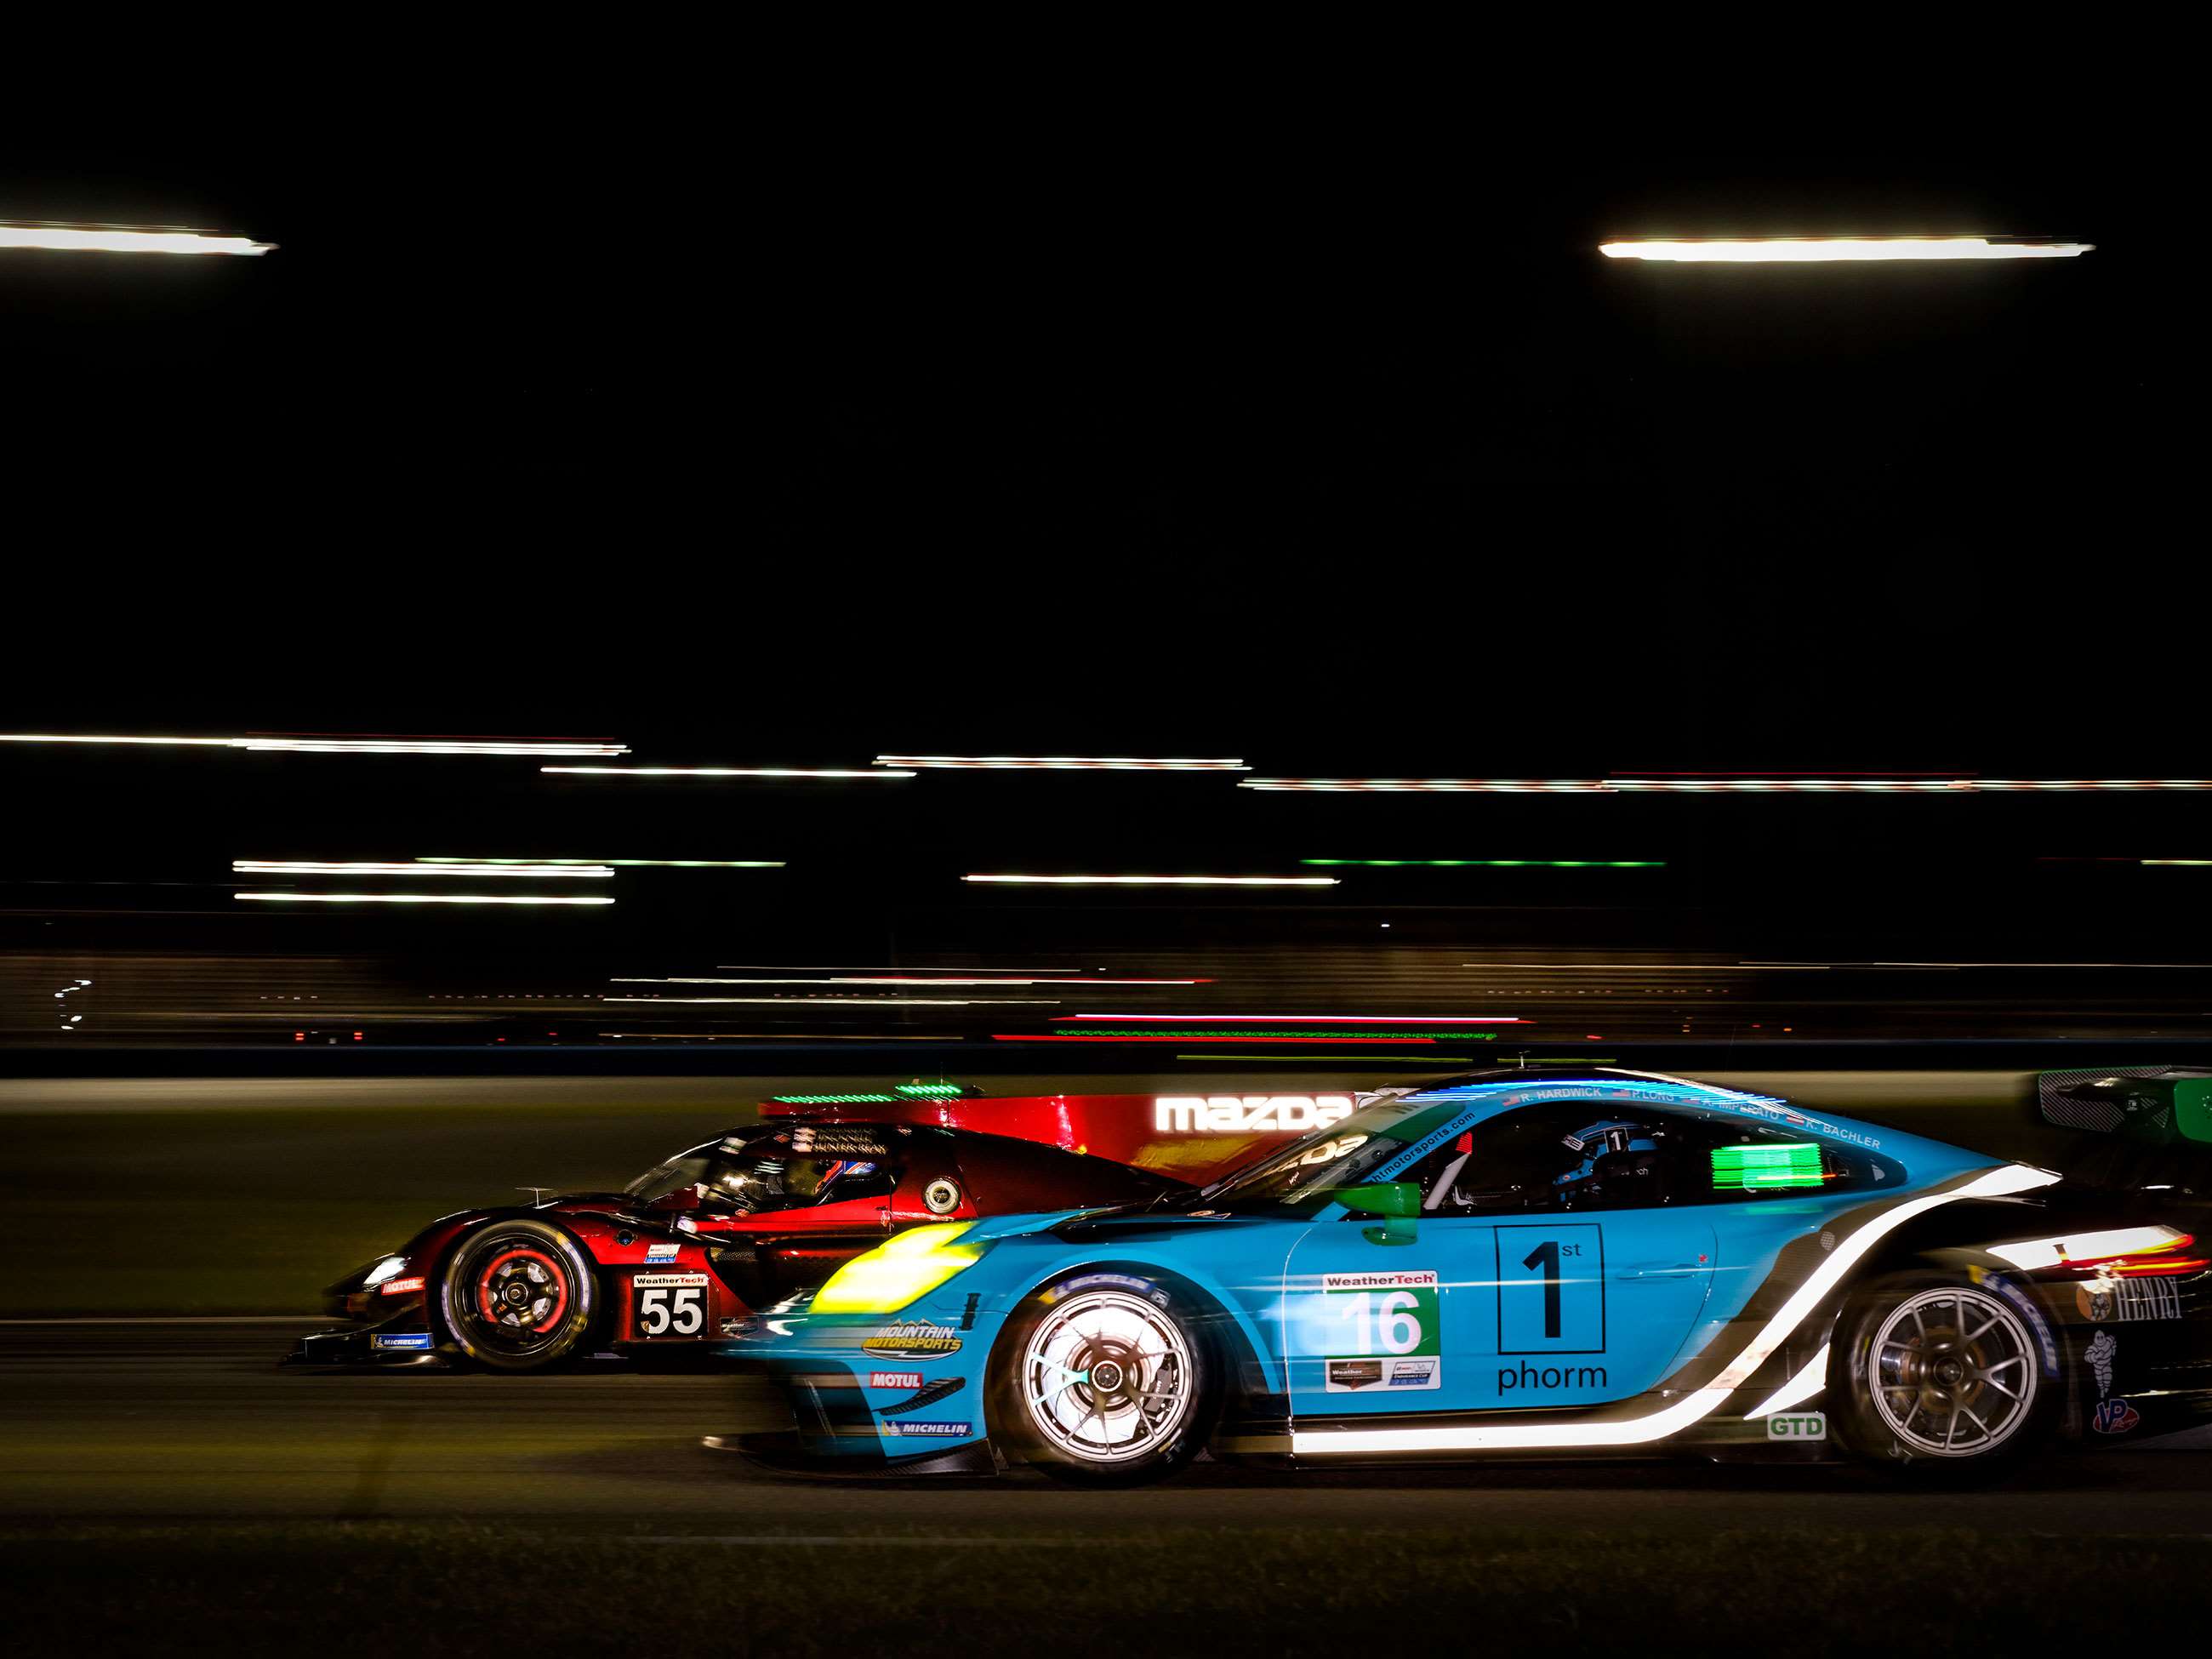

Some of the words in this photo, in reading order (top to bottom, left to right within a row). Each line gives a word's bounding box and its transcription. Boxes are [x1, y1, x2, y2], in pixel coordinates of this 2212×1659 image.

[1520, 1092, 1534, 1103] R.
[1536, 1087, 1602, 1099] HARDWICK
[1822, 1124, 1880, 1149] BACHLER
[1371, 1111, 1476, 1183] htmotorsports.com
[636, 1276, 704, 1285] WeatherTech
[1327, 1274, 1434, 1286] WeatherTech
[2113, 1277, 2183, 1320] HENRY
[641, 1289, 703, 1334] 55
[875, 1325, 956, 1339] MOUNTAIN
[1342, 1291, 1422, 1354] 16
[863, 1337, 962, 1350] MOTORSPORTS
[872, 1373, 921, 1388] MOTUL
[1498, 1360, 1606, 1396] phorm
[2096, 1399, 2128, 1434] VP
[903, 1422, 968, 1434] MICHELIN
[1770, 1417, 1823, 1436] GTD
